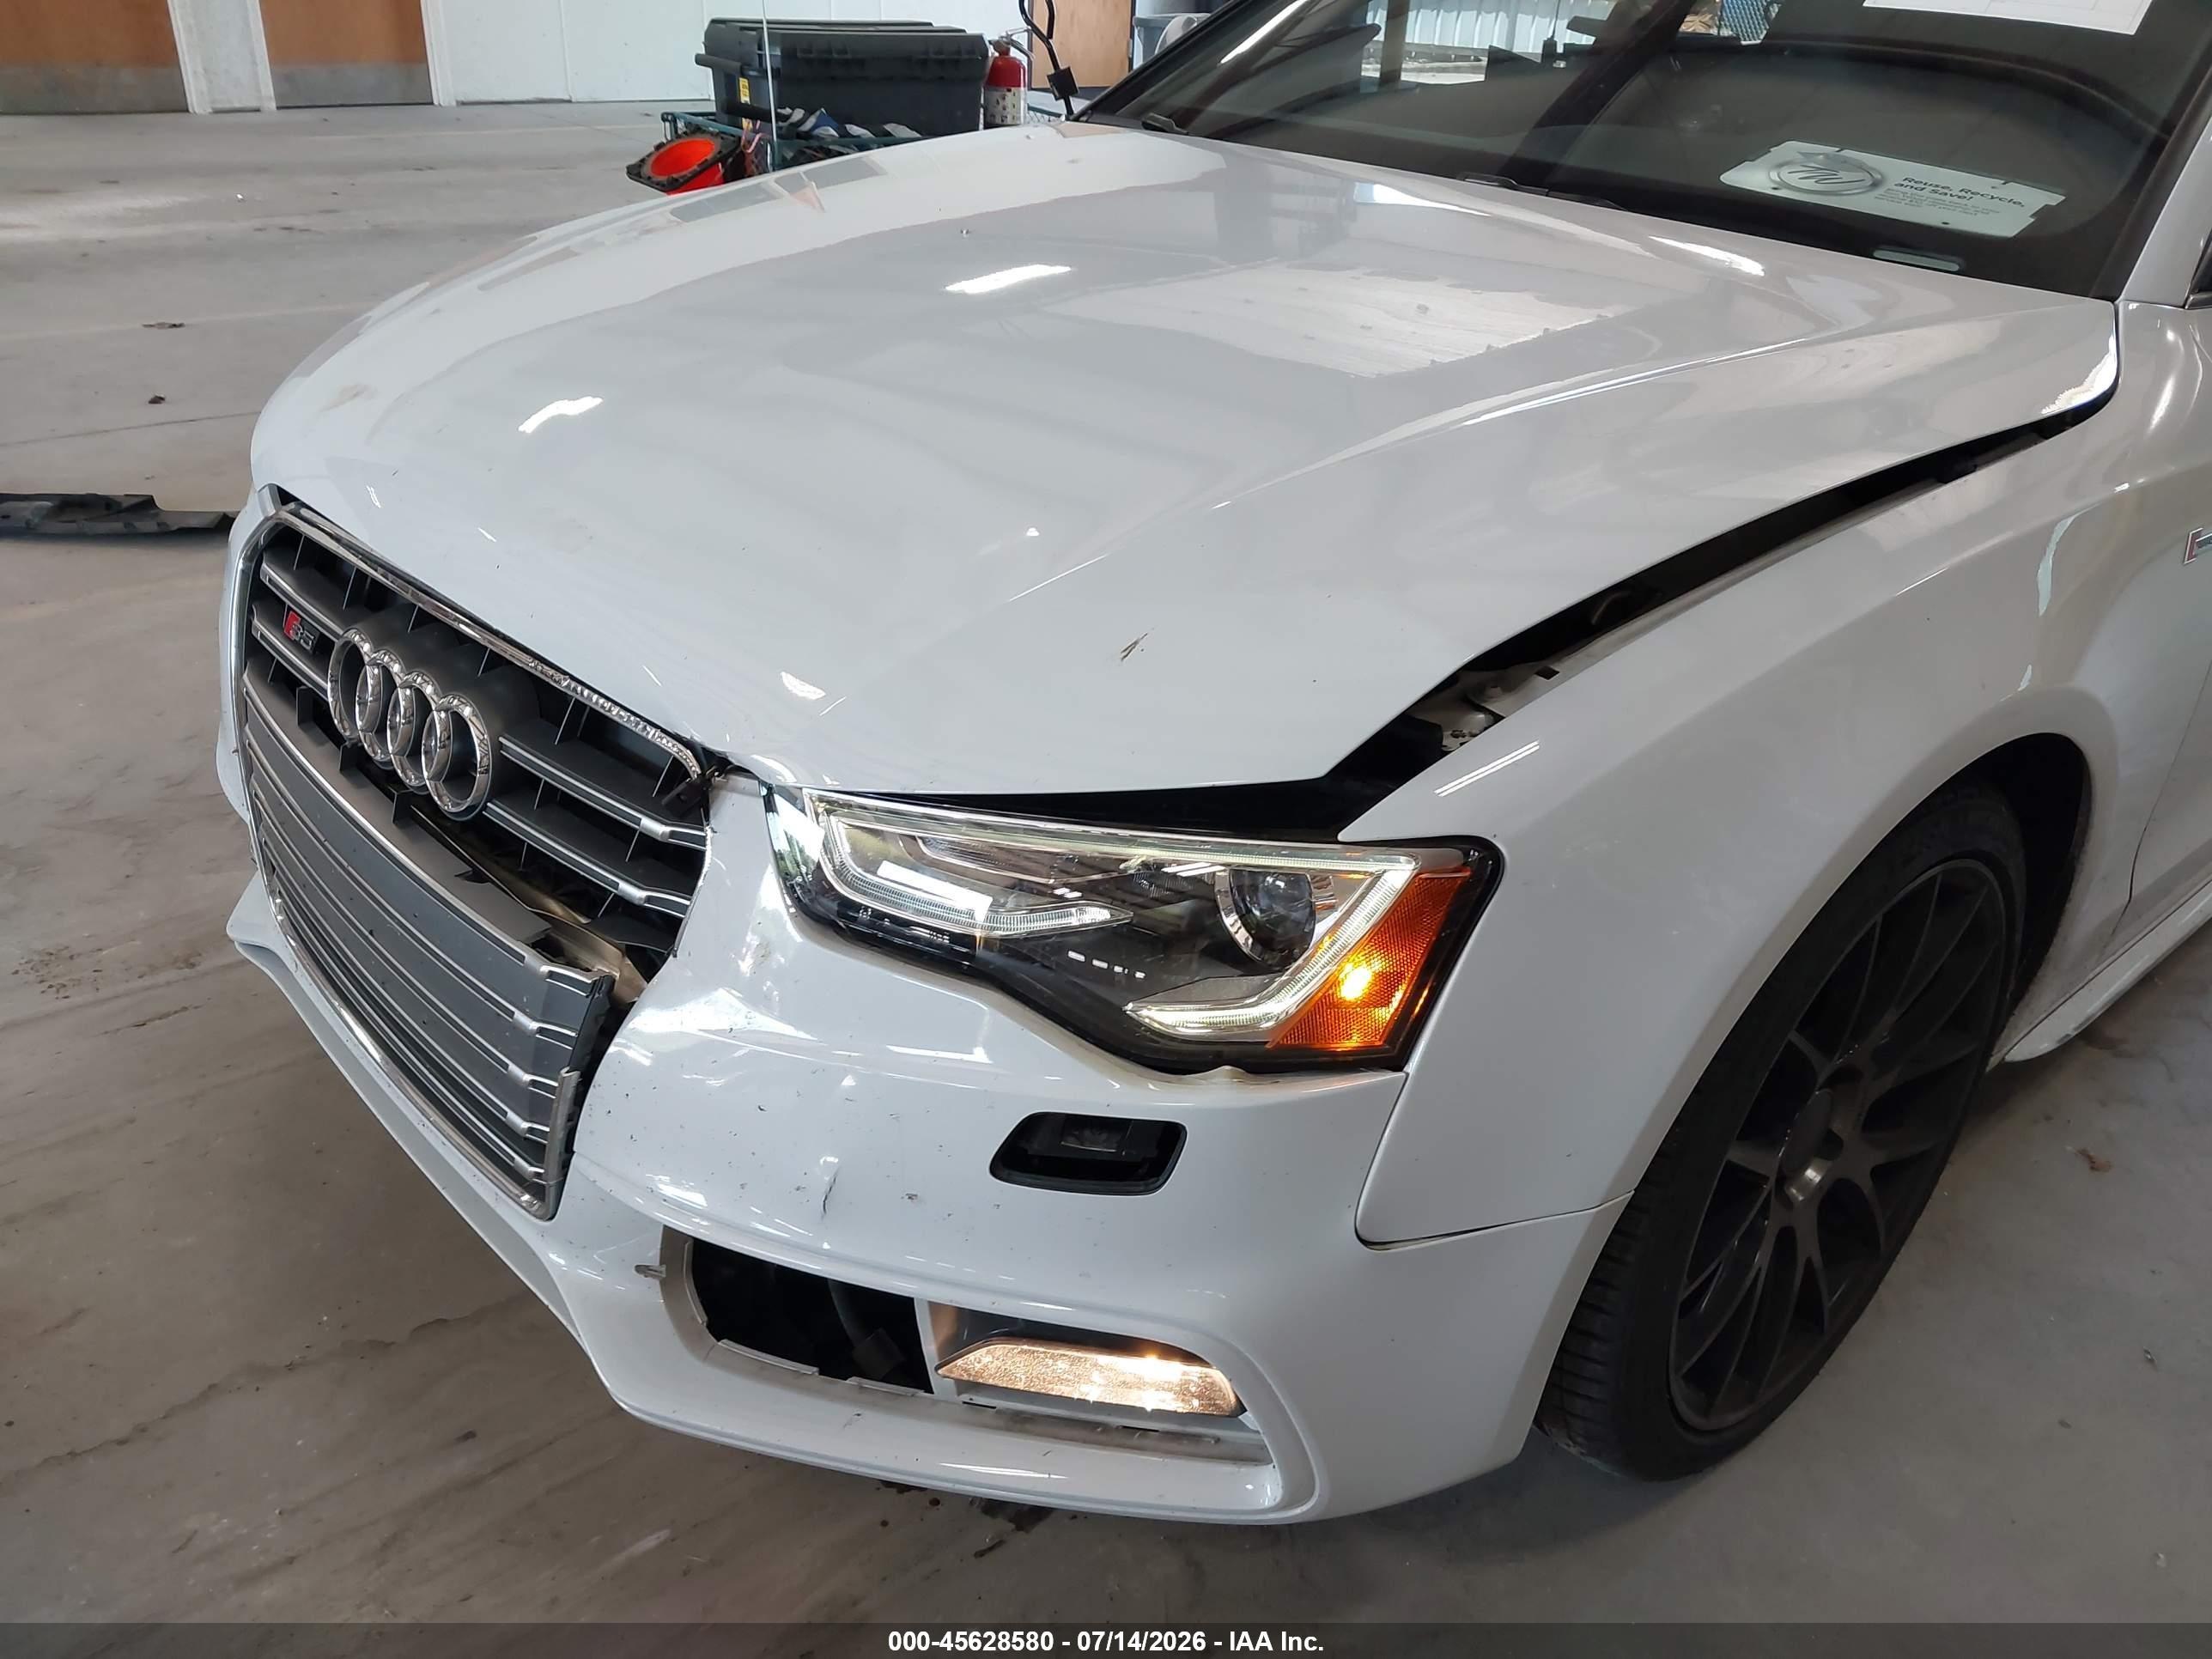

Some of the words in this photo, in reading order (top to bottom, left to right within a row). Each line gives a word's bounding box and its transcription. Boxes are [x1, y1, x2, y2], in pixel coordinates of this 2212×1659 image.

[1893, 183, 1927, 191] and
[1929, 188, 1973, 201] Save!
[1902, 177, 1953, 191] Reuse,
